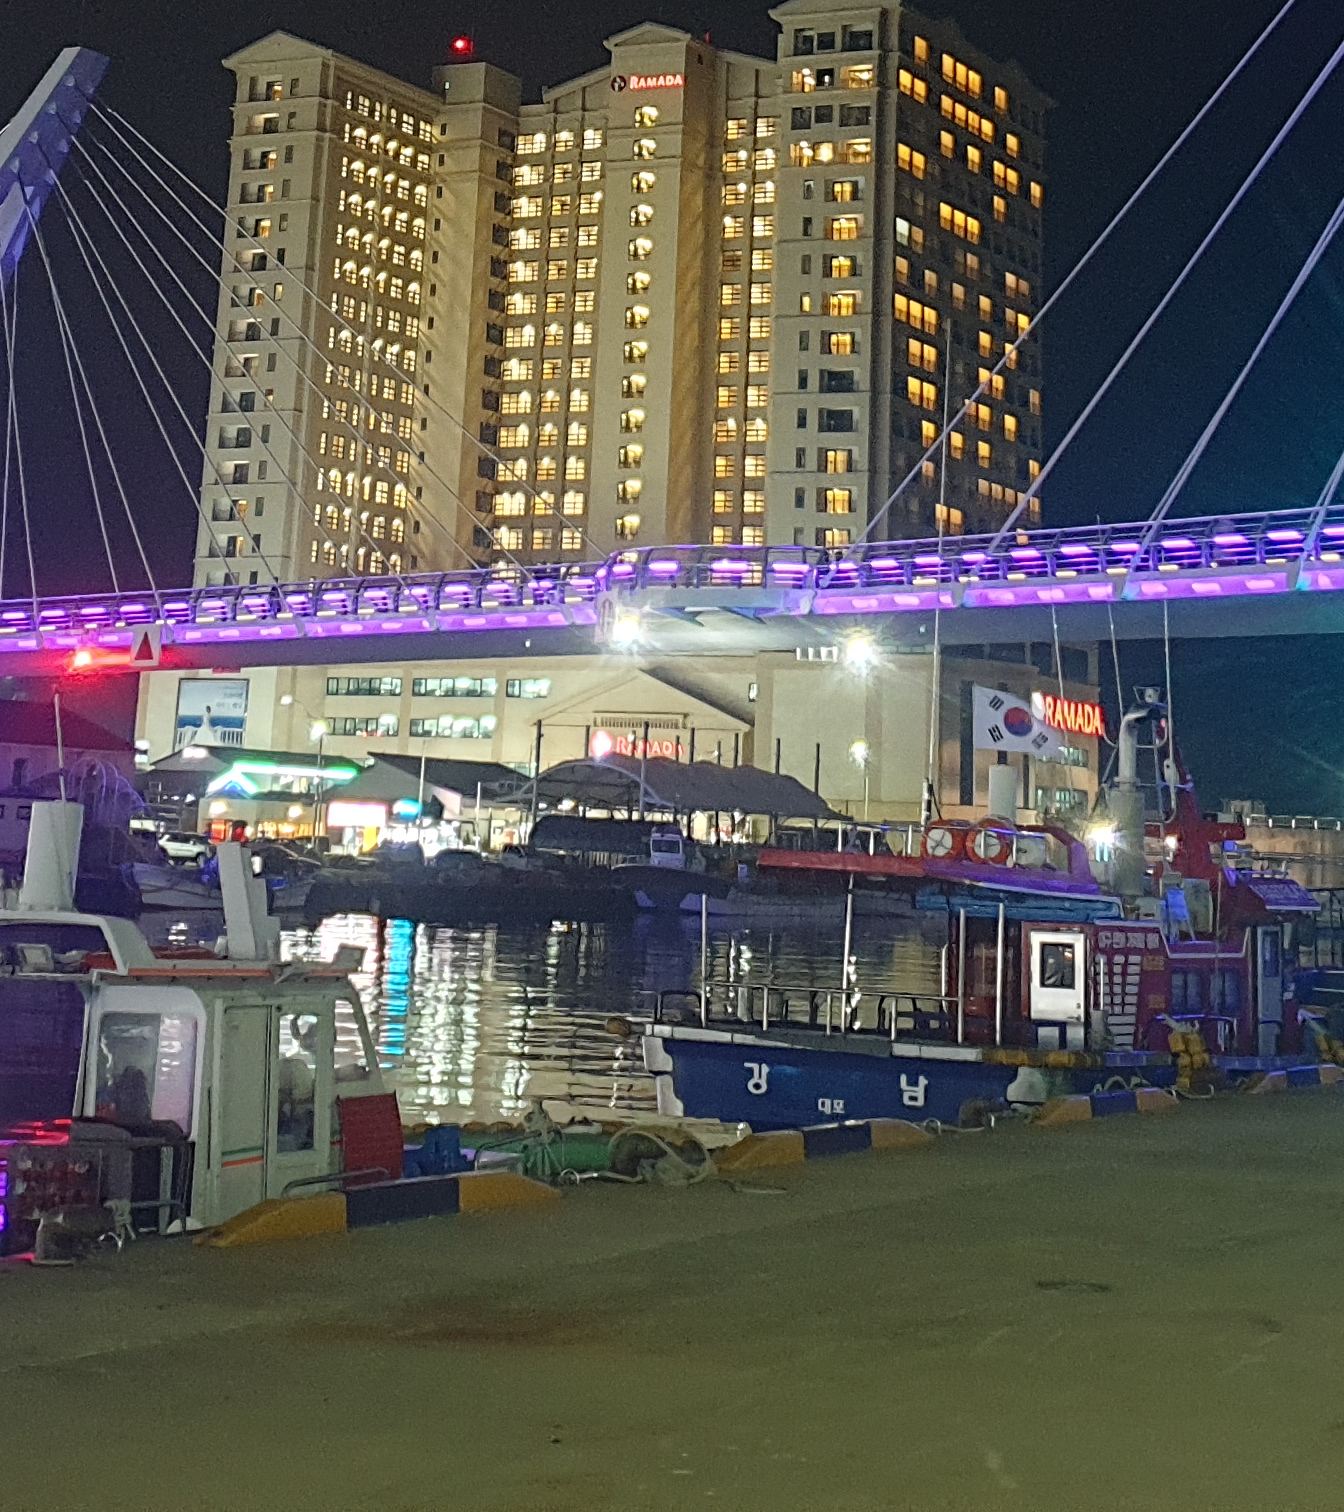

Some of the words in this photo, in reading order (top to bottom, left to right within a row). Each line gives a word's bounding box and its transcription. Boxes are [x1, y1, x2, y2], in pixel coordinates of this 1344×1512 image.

[630, 74, 684, 90] RAMADA
[1045, 695, 1102, 736] RAMADA
[743, 1062, 770, 1095] 강
[900, 1073, 929, 1108] 남
